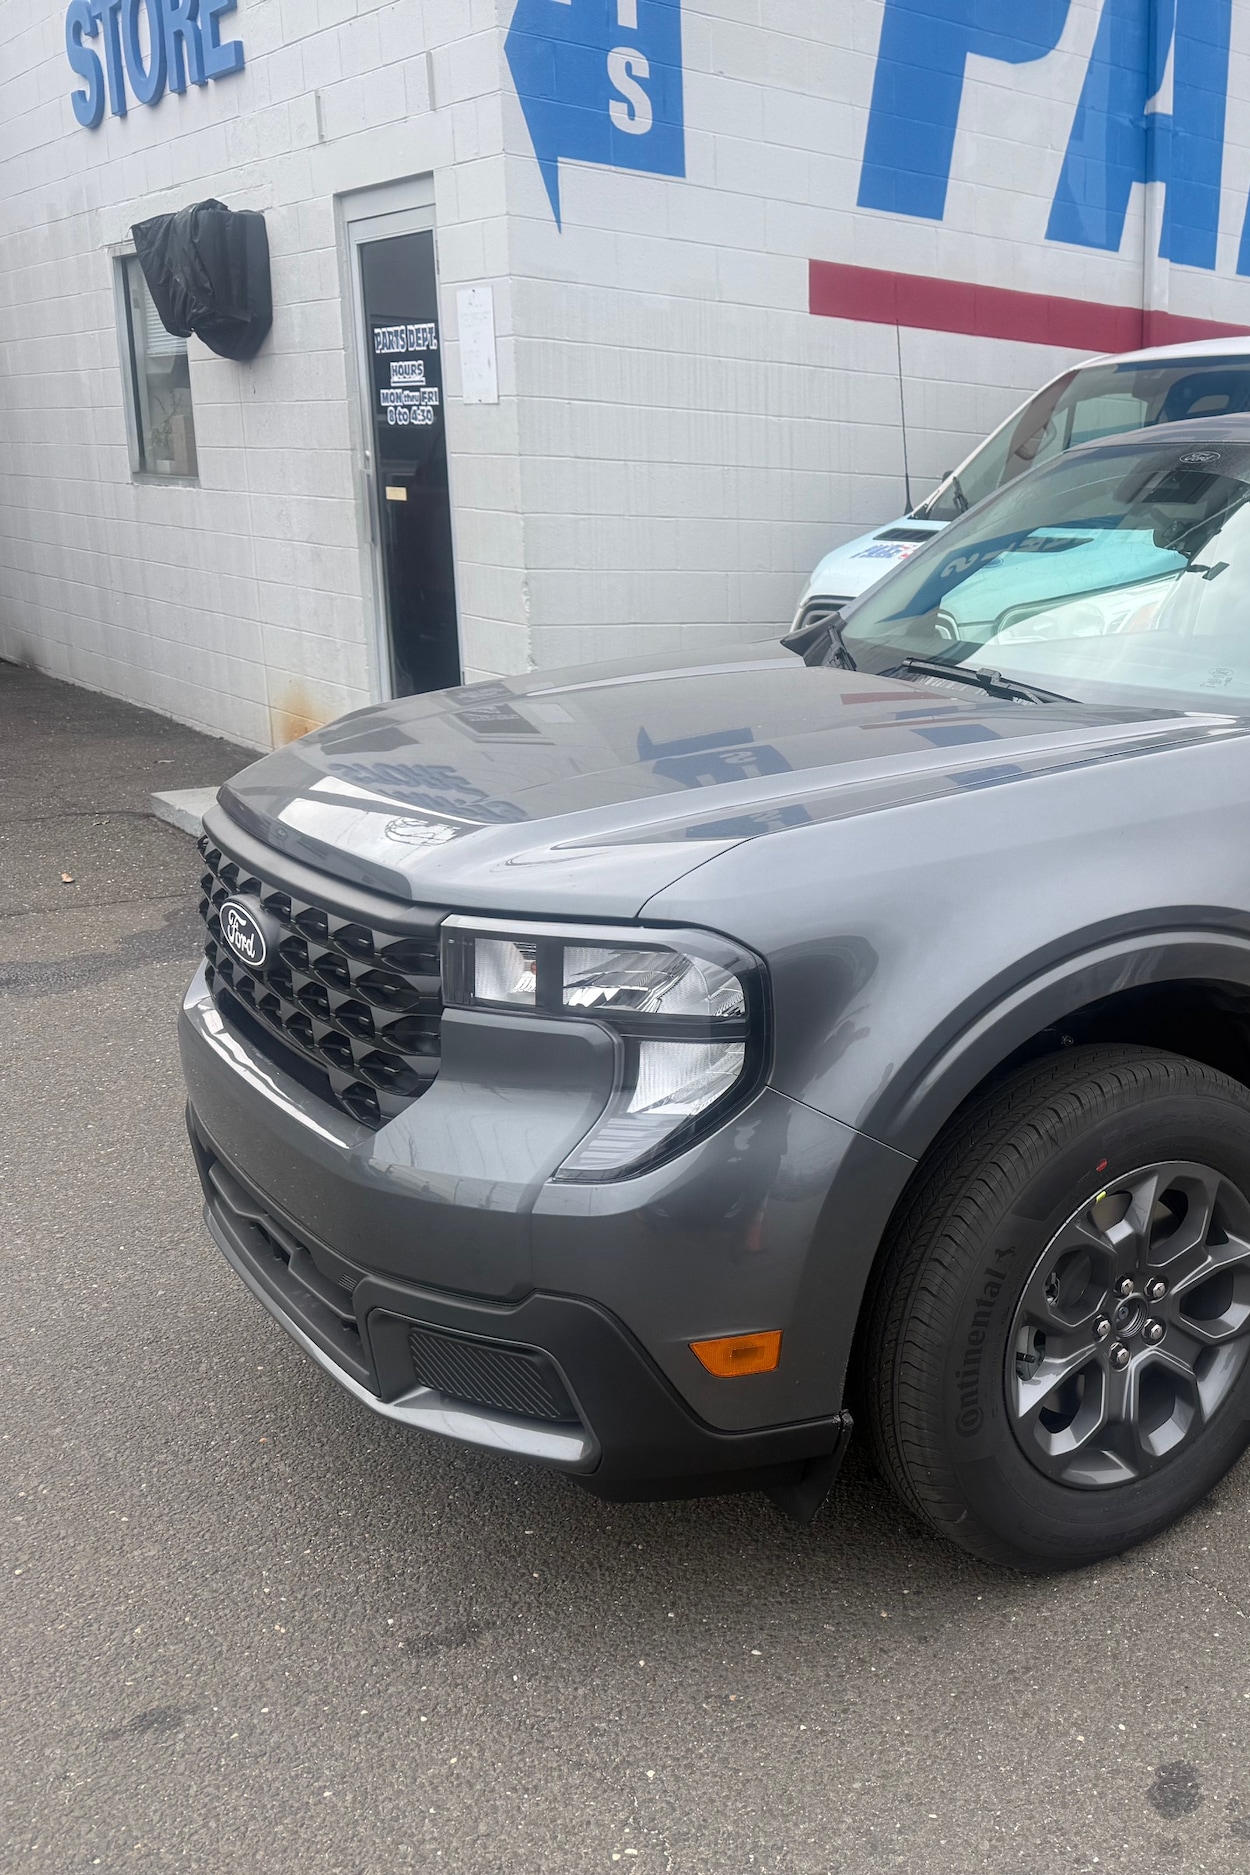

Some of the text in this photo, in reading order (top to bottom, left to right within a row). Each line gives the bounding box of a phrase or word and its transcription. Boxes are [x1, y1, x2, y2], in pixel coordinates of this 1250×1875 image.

[65, 0, 245, 129] STORE
[374, 323, 437, 353] PARTS DEPT.
[390, 360, 424, 379] HOURS
[380, 389, 403, 406] MON
[420, 387, 439, 405] FRI
[387, 406, 434, 425] 8 to 4:30
[227, 908, 256, 958] Ford
[955, 1267, 1007, 1438] Continental
